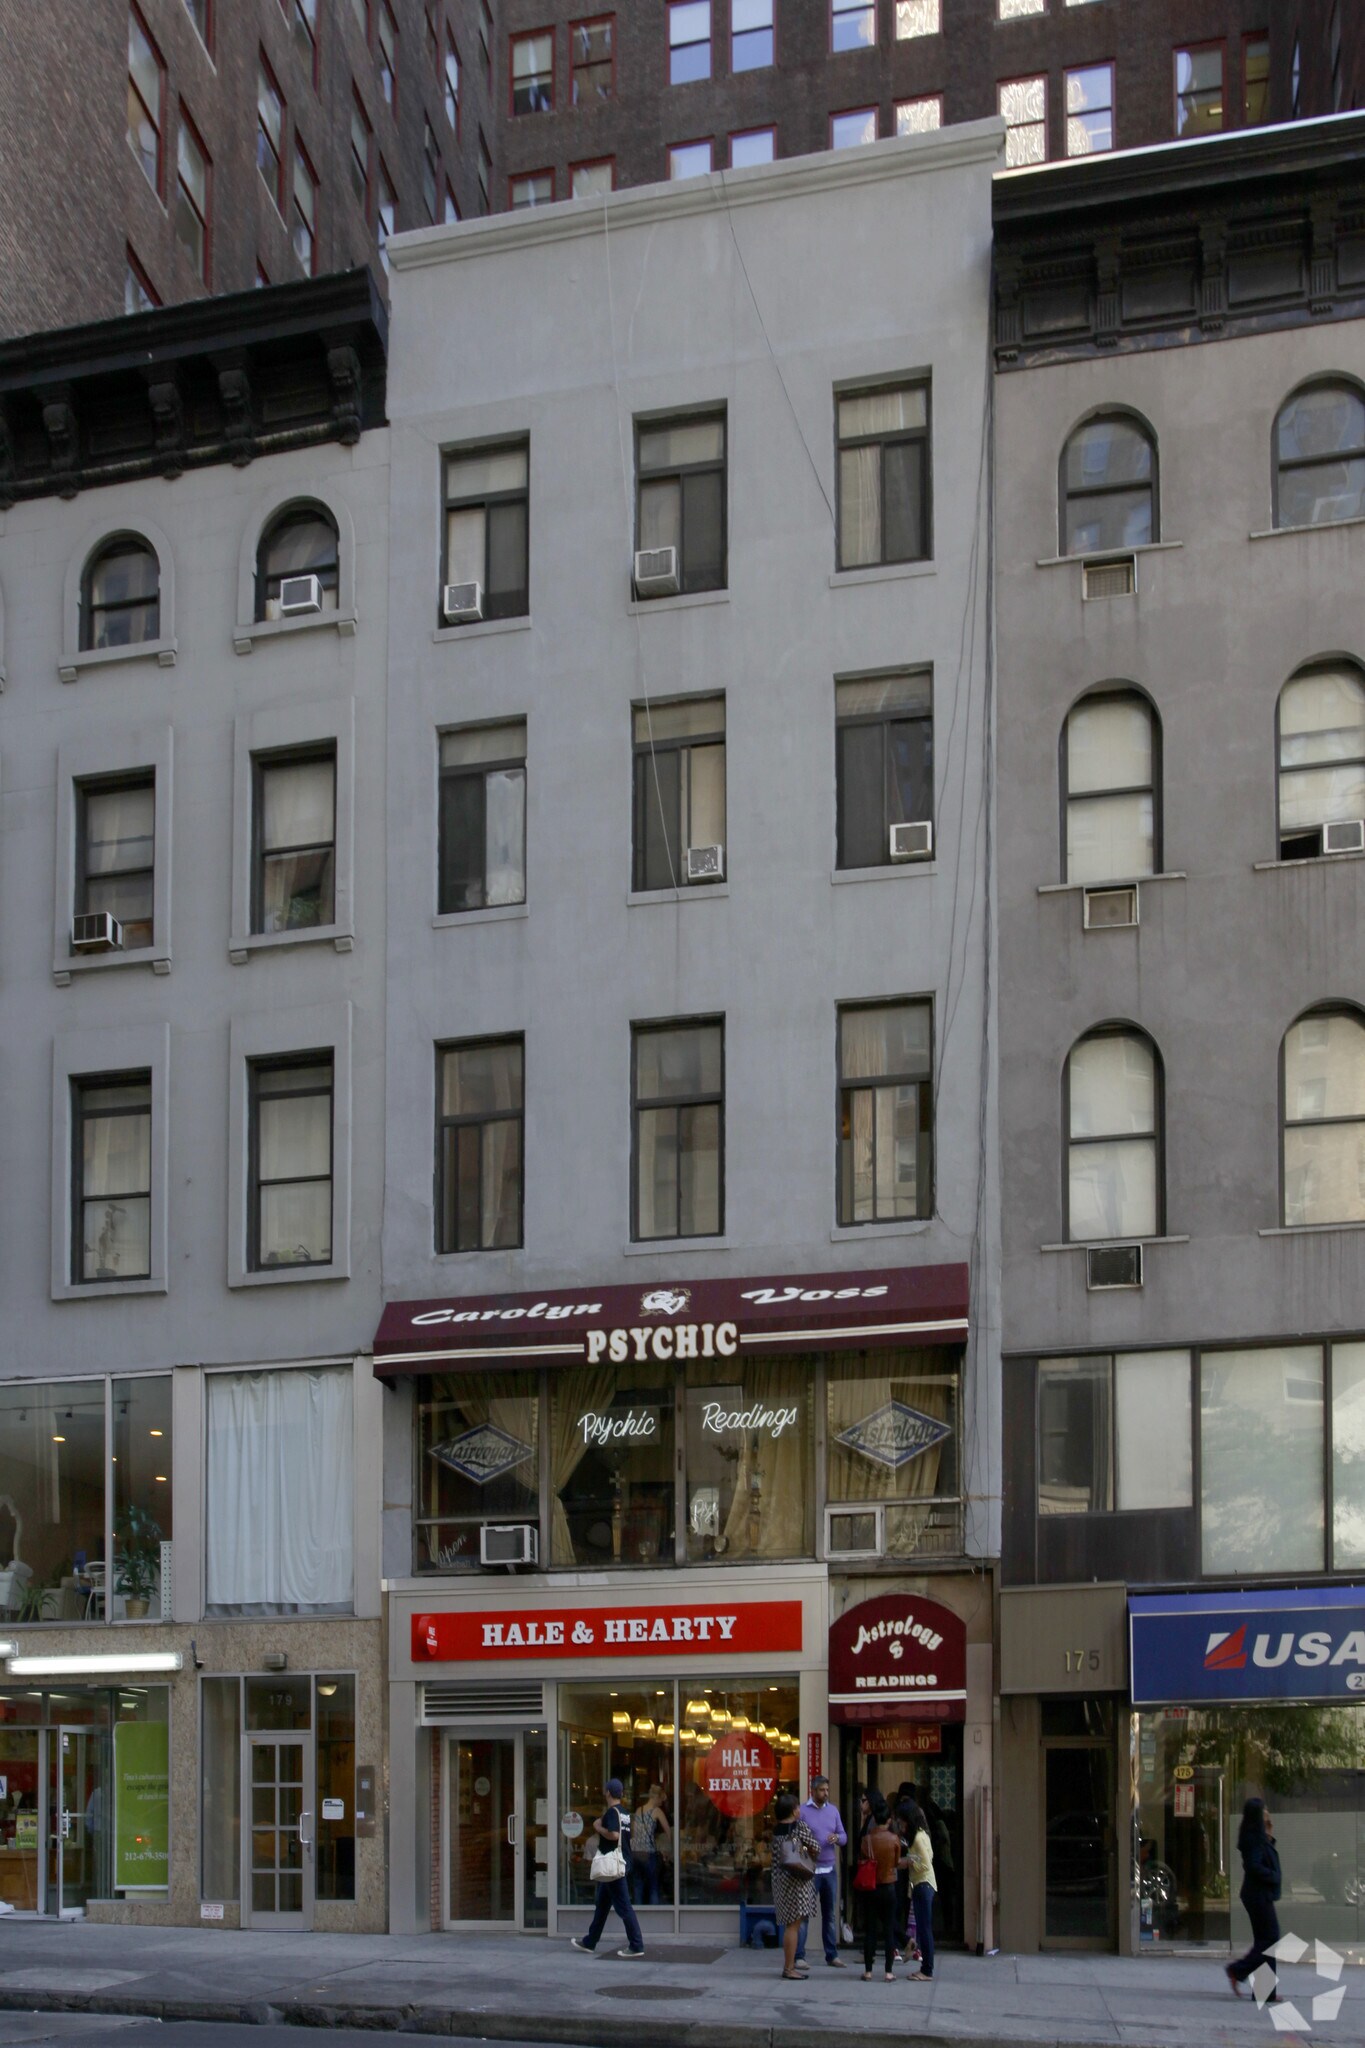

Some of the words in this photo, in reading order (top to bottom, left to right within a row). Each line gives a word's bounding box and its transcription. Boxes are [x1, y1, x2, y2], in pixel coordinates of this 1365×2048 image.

[411, 1301, 602, 1326] Carolyn
[741, 1285, 889, 1305] Voss
[587, 1322, 738, 1364] PSYCHIC
[577, 1410, 656, 1445] Psychic
[702, 1402, 798, 1438] Readings
[482, 1622, 565, 1646] HALE
[571, 1620, 595, 1644] &
[604, 1616, 737, 1643] HEARTY
[850, 1614, 944, 1655] Astrology
[1252, 1630, 1365, 1668] USA
[1065, 1650, 1100, 1672] 175
[855, 1674, 938, 1687] READINGS
[270, 1694, 292, 1706] 179
[876, 1728, 899, 1739] PALM
[865, 1739, 911, 1751] READINGS
[722, 1748, 760, 1767] HALE
[1176, 1768, 1191, 1778] 175
[708, 1778, 773, 1791] HEARTY
